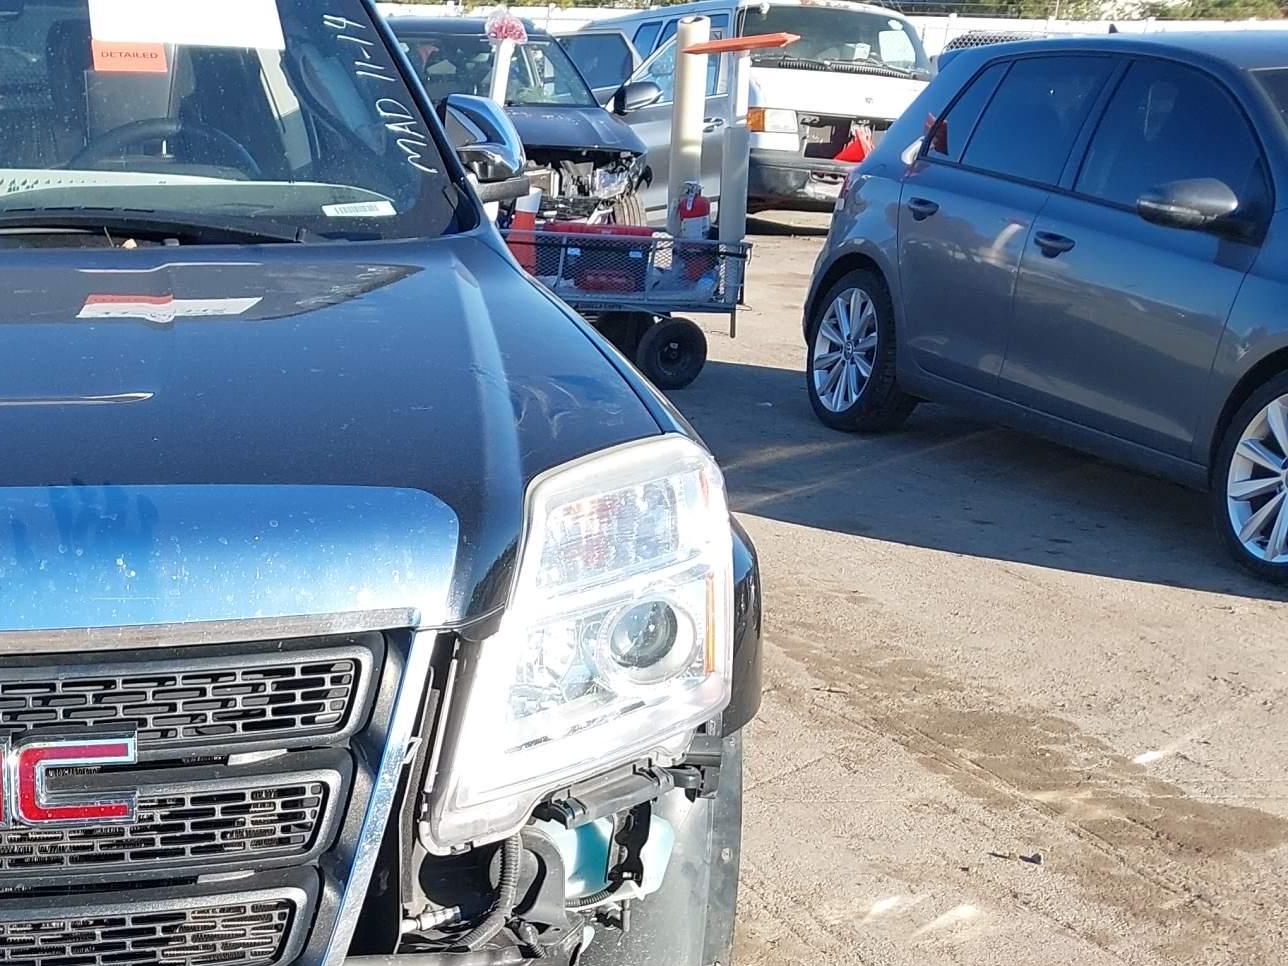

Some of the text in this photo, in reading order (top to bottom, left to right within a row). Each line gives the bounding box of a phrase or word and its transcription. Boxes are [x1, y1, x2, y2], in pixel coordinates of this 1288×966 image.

[100, 50, 159, 60] DETAILED
[323, 14, 439, 174] MAD 11-14
